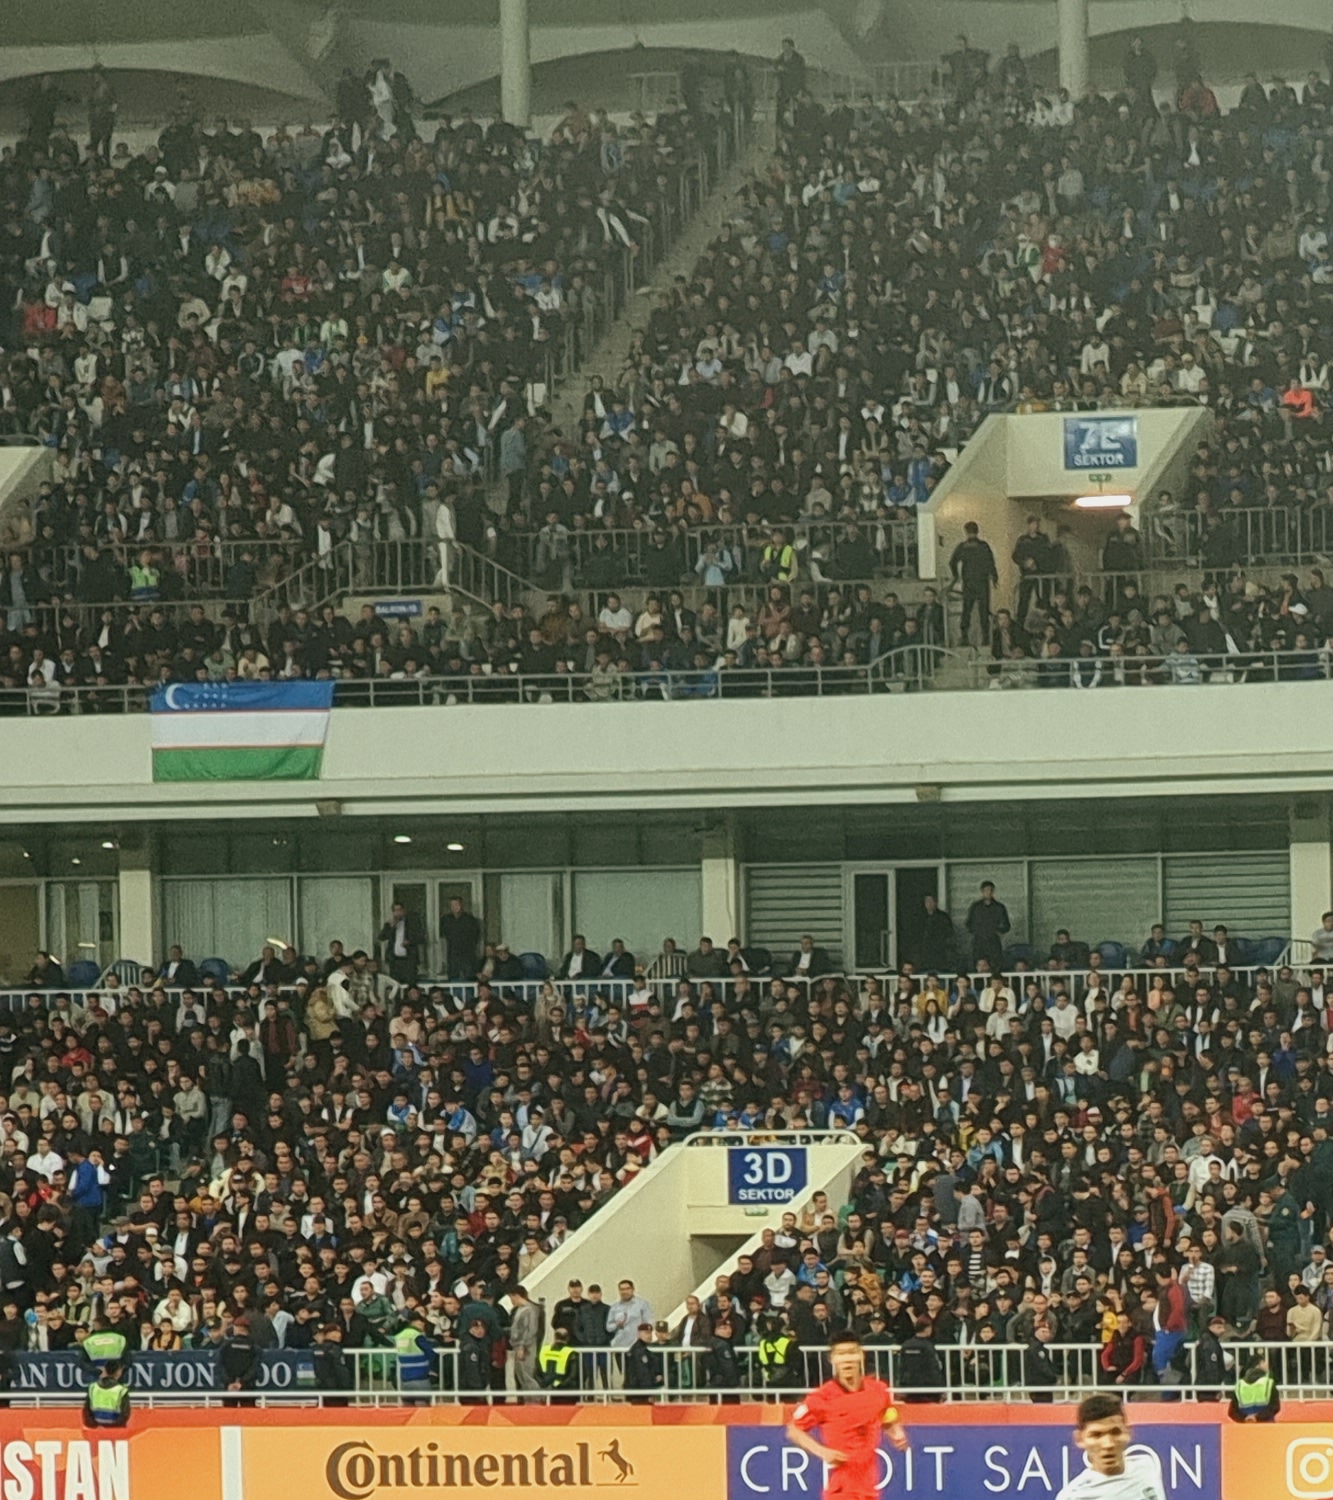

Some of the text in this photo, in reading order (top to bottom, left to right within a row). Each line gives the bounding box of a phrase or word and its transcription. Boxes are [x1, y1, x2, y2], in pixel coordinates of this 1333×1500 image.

[743, 1152, 792, 1184] 3D
[738, 1188, 794, 1200] SEKTOR
[160, 1362, 216, 1388] JON
[325, 1440, 593, 1500] Continental
